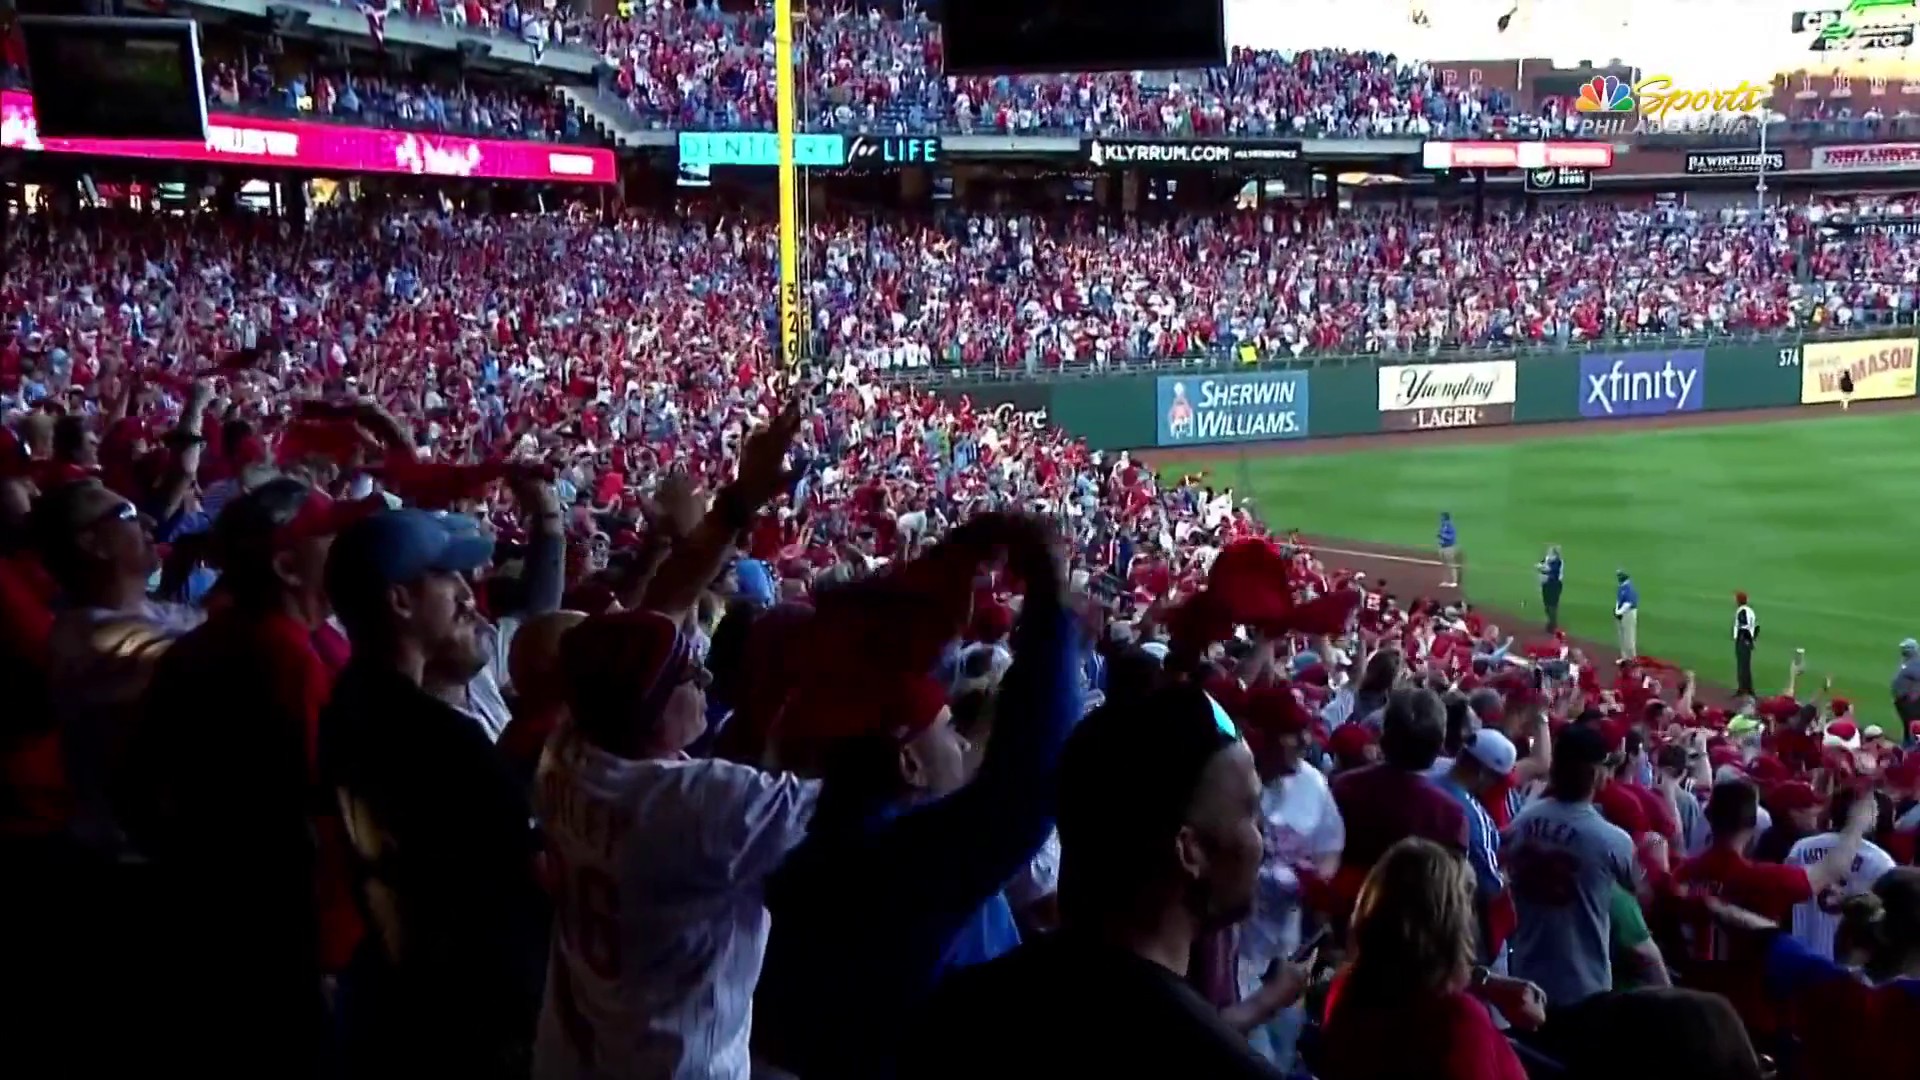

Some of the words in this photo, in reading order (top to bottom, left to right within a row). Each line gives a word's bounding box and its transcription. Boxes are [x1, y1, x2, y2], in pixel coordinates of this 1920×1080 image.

[848, 136, 880, 163] for
[883, 138, 937, 162] LIFE
[1104, 145, 1230, 161] KLYRRUM.COM
[1818, 346, 1914, 394] WMASON
[1198, 379, 1296, 408] SHERWIN
[1396, 368, 1500, 407] Yuengling
[1587, 359, 1698, 414] xfinity
[1417, 406, 1477, 429] LAGER
